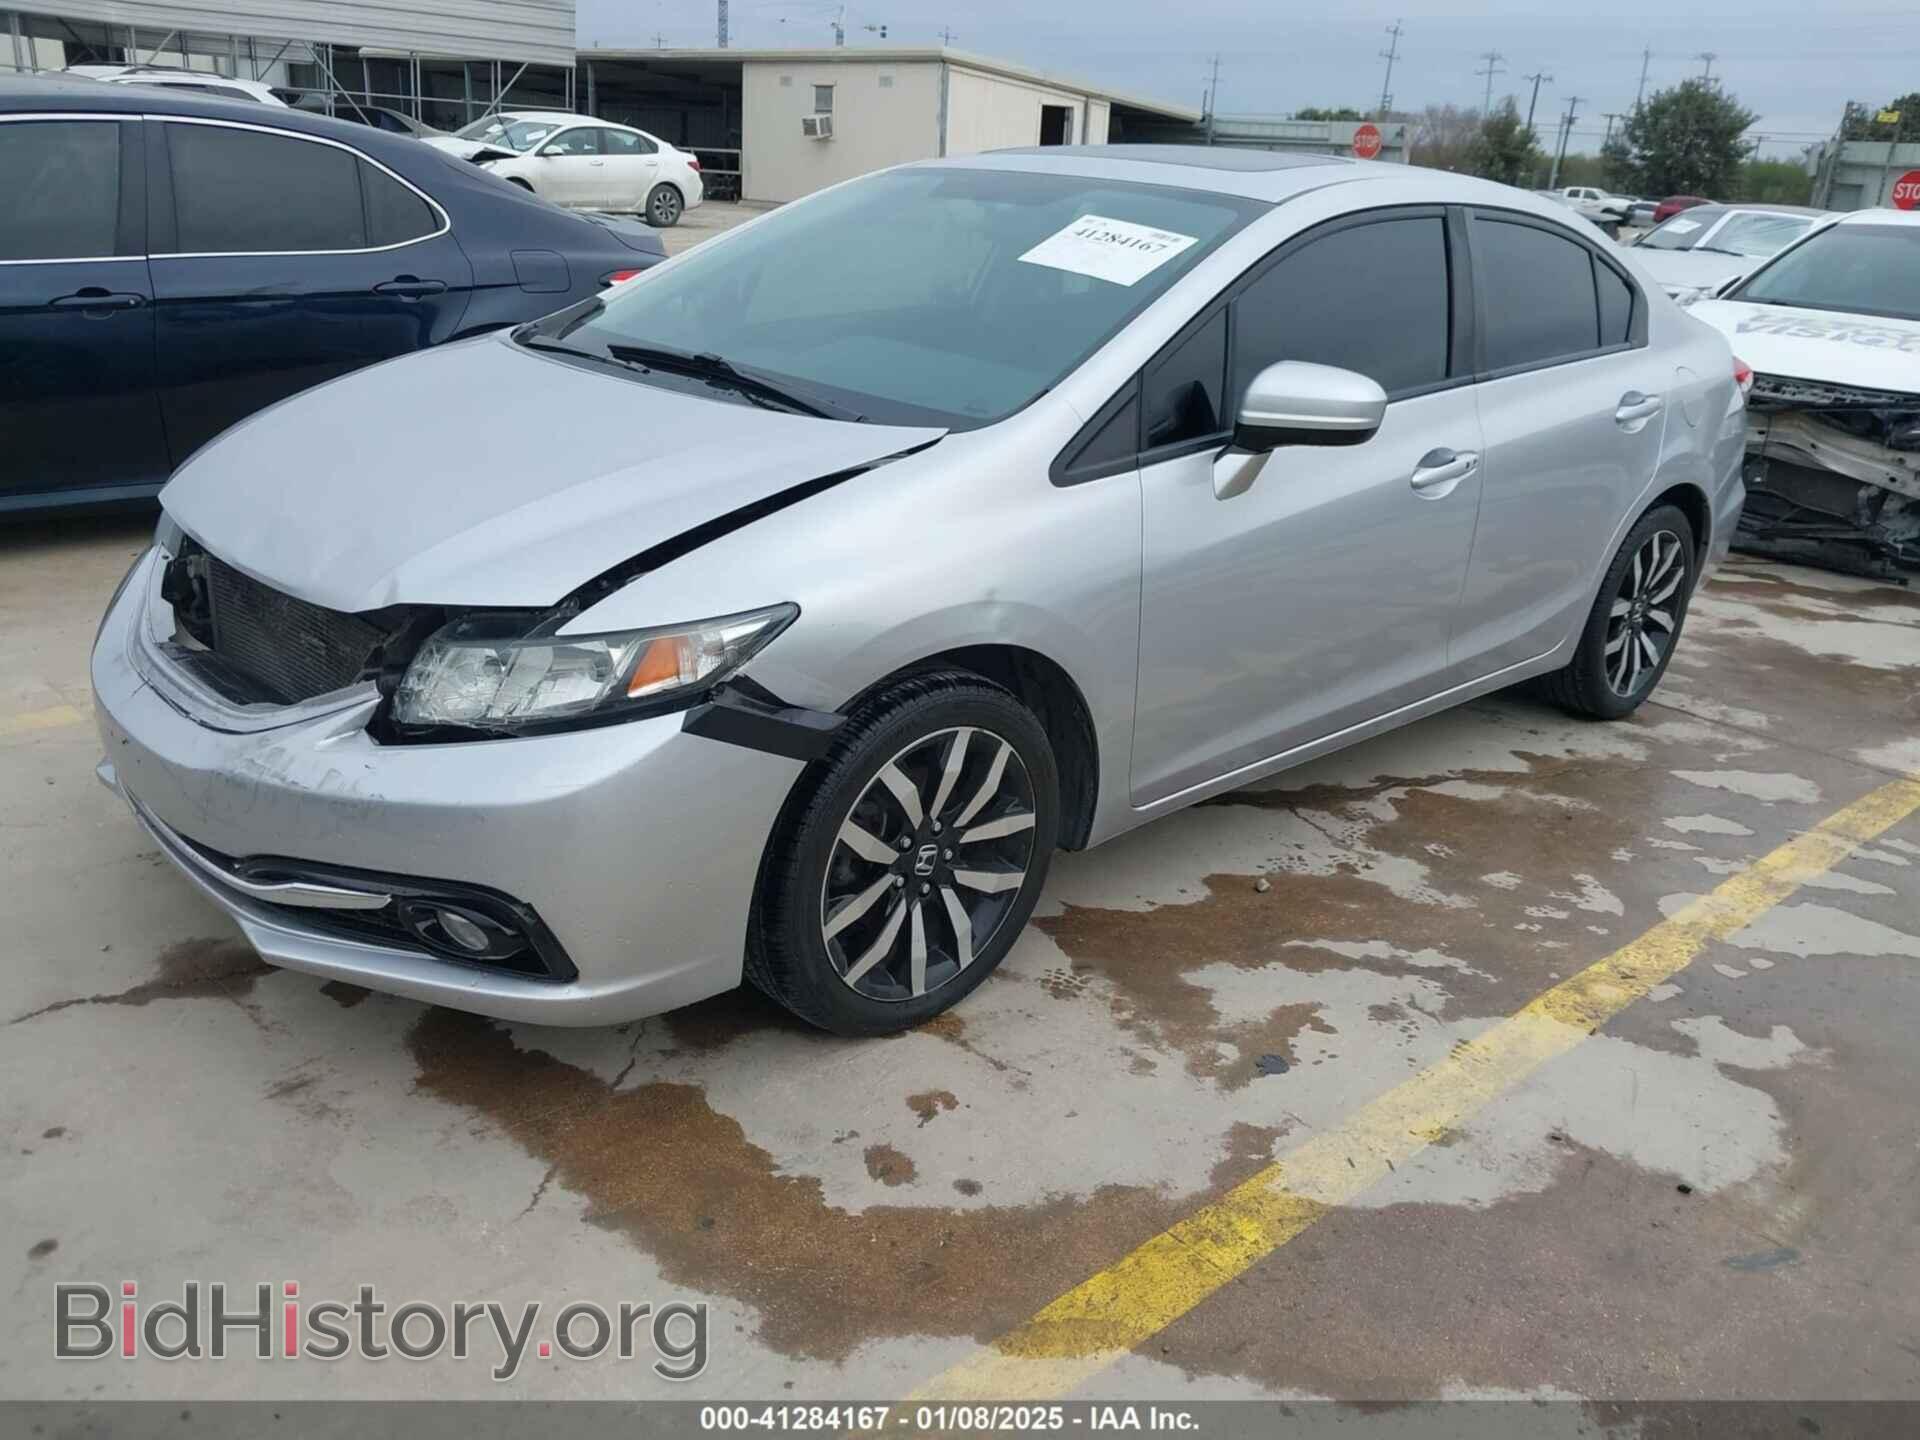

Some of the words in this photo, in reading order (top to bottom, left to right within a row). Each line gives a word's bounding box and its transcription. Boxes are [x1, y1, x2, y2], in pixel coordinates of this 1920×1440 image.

[1355, 129, 1379, 148] STOP
[1894, 182, 1920, 200] STO
[1073, 227, 1169, 254] 41284167
